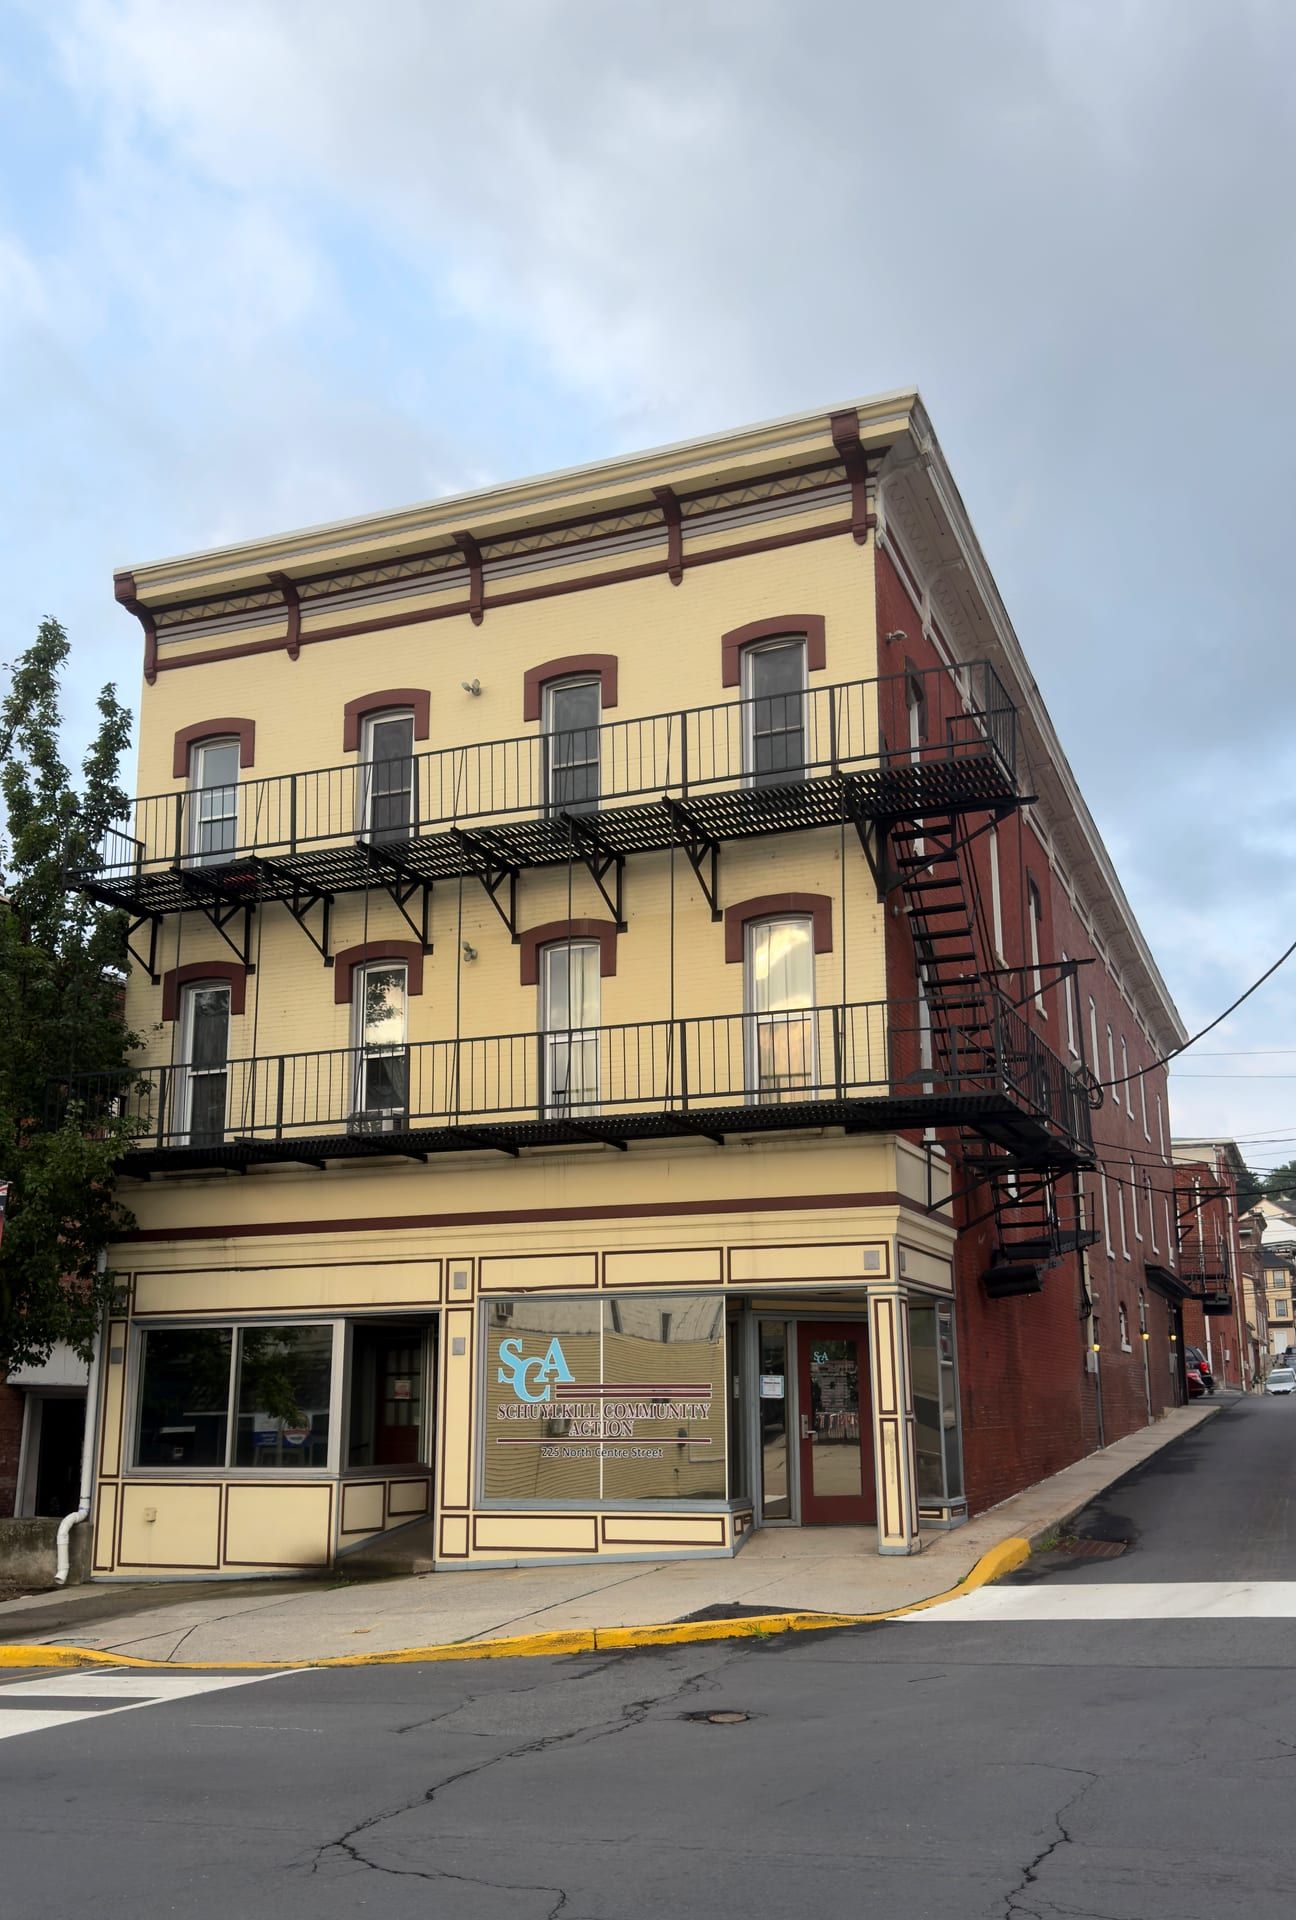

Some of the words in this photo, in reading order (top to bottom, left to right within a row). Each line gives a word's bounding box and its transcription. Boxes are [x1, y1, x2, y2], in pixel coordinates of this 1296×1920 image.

[497, 1403, 599, 1419] SCHUYLKILL
[603, 1403, 711, 1419] COMMUNITY
[569, 1420, 634, 1436] ACTION
[541, 1447, 559, 1457] 225
[563, 1447, 592, 1457] North
[595, 1447, 629, 1457] Centre
[632, 1447, 663, 1457] Street
